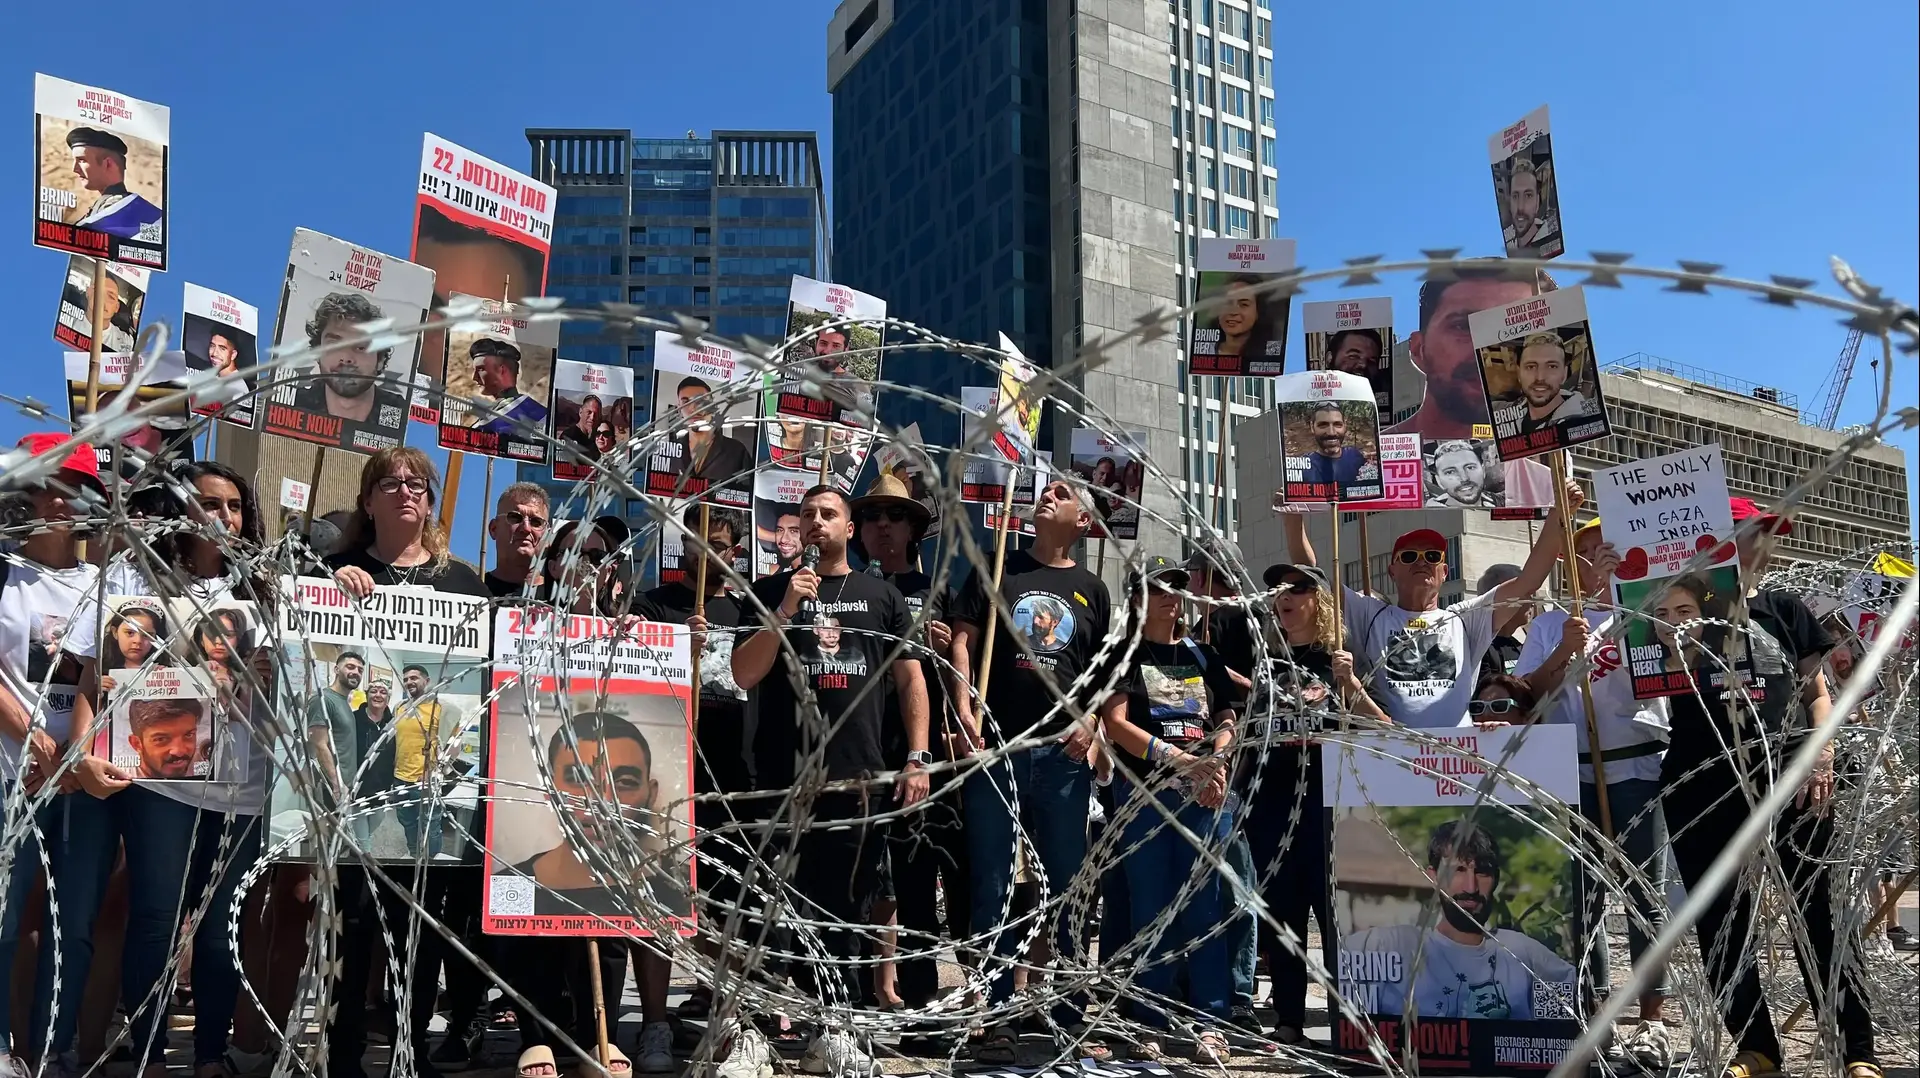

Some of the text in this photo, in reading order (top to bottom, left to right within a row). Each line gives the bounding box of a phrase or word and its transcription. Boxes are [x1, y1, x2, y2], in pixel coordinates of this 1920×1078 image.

[77, 98, 133, 121] MATAN ANGREST
[432, 146, 454, 174] 22
[421, 172, 438, 194] !!!
[40, 186, 77, 208] BRING
[452, 186, 473, 207] סוג
[475, 194, 498, 218] אינו
[520, 184, 546, 213] מתן
[39, 206, 63, 223] HIM
[500, 205, 527, 230] פצוע
[529, 214, 550, 239] חייל
[39, 222, 72, 244] HOME
[75, 230, 109, 251] NOW!
[351, 248, 382, 269] אלון אהל
[328, 270, 342, 282] 24
[344, 260, 382, 282] ALON OHEL
[59, 311, 74, 328] HIM
[61, 300, 85, 321] BRING
[1504, 306, 1551, 327] ELKANA BOHBOT
[56, 324, 77, 344] HOME
[1195, 328, 1220, 342] BRING
[1194, 341, 1209, 355] HER
[688, 352, 735, 370] ROM BRASLAVSKI
[1192, 355, 1241, 370] HOME NOW!
[1311, 382, 1327, 390] TAMIR
[781, 394, 833, 416] HOME NOW!
[1494, 404, 1524, 424] BRING
[268, 404, 303, 430] HOME
[306, 416, 343, 438] NOW!
[442, 410, 461, 426] HIM
[441, 426, 469, 445] HOME
[470, 431, 499, 451] NOW!
[1497, 422, 1517, 439] HIM
[1500, 426, 1559, 454] HOME NOW!
[651, 454, 671, 473] HIM
[1285, 456, 1312, 470] BRING
[1609, 453, 1712, 486] THE ONLY
[963, 472, 976, 484] HIM
[1286, 469, 1303, 482] HIM
[778, 486, 796, 494] EVYATAR
[1287, 483, 1312, 496] HOME
[1625, 481, 1696, 506] WOMAN
[1628, 505, 1705, 533] IN GAZA
[1657, 521, 1713, 542] INBAR
[662, 556, 679, 569] HIM
[757, 552, 777, 565] BRING
[1648, 549, 1696, 566] INBAR HAYMAN
[1667, 561, 1680, 572] (27)
[757, 563, 770, 575] HIM
[391, 594, 424, 616] ברמן
[428, 598, 453, 619] וזיו
[816, 600, 869, 613] Braslavski
[360, 616, 423, 643] הניצחון
[428, 622, 479, 649] תמונת
[637, 622, 674, 648] מתן
[1630, 644, 1663, 662] BRING
[167, 671, 175, 679] דוד
[811, 663, 867, 677] לא משאירים את
[1632, 660, 1653, 677] HER
[146, 679, 181, 687] DAVID CUNIO
[1635, 675, 1665, 693] HOME
[1163, 725, 1184, 737] HOME
[1286, 716, 1324, 732] THEM
[112, 755, 141, 768] BRING
[1413, 757, 1438, 776] GUY
[1338, 950, 1402, 982] BRING
[1339, 1019, 1398, 1050] HOME
[1494, 1035, 1531, 1048] HOSTAGES
[1531, 1037, 1546, 1049] AND
[1494, 1049, 1541, 1064] FAMILIES
